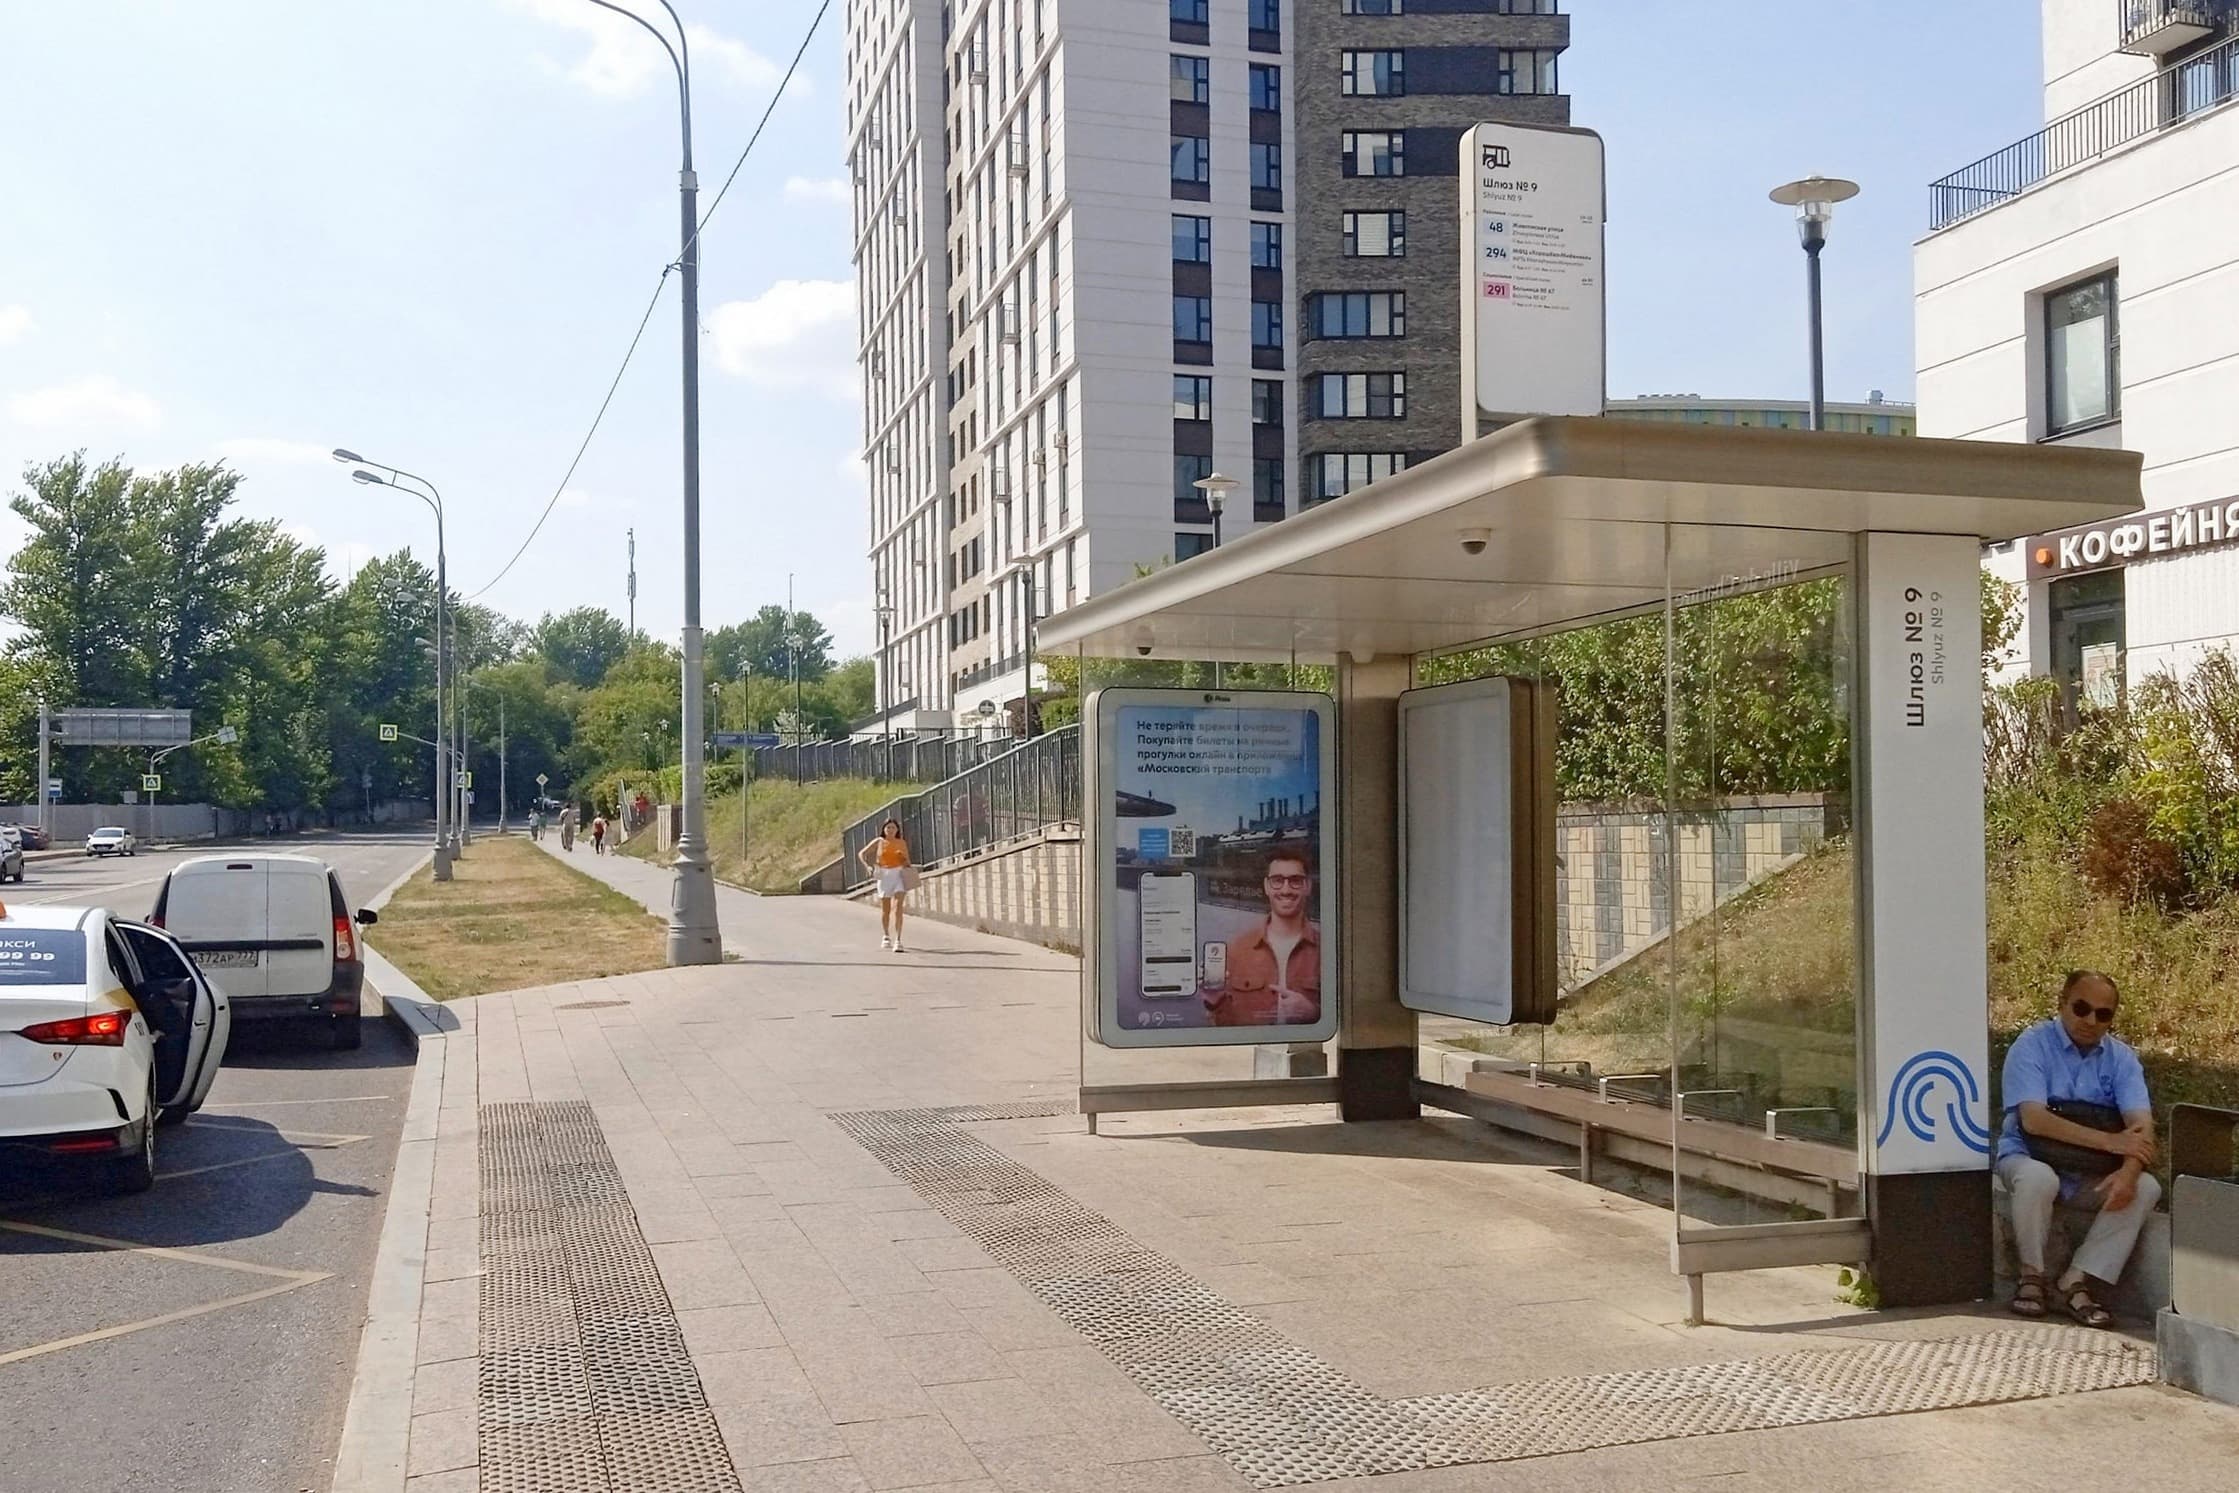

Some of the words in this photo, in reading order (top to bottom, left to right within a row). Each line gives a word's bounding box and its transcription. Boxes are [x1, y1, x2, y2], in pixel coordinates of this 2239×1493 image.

[1482, 178, 1513, 190] Шлюз
[1516, 180, 1529, 192] №
[1530, 182, 1538, 192] 9
[1489, 221, 1504, 233] 48
[1485, 247, 1507, 259] 294
[1487, 284, 1506, 296] 291
[2060, 502, 2239, 569] КОФЕЙНЯ
[1904, 587, 1923, 602] 9
[1930, 591, 1943, 602] 9
[1931, 607, 1943, 628] №
[1905, 611, 1923, 642] №
[1931, 633, 1946, 684] Shlyuz
[1907, 652, 1924, 726] Шлюз
[1137, 720, 1151, 731] Не
[1154, 722, 1194, 732] теряйте
[1137, 735, 1193, 746] Покупайте
[1196, 735, 1235, 745] билеты
[1137, 750, 1186, 760] прогулки
[1189, 750, 1227, 759] онлайн
[1137, 763, 1211, 774] «Московский
[30, 952, 55, 961] 99
